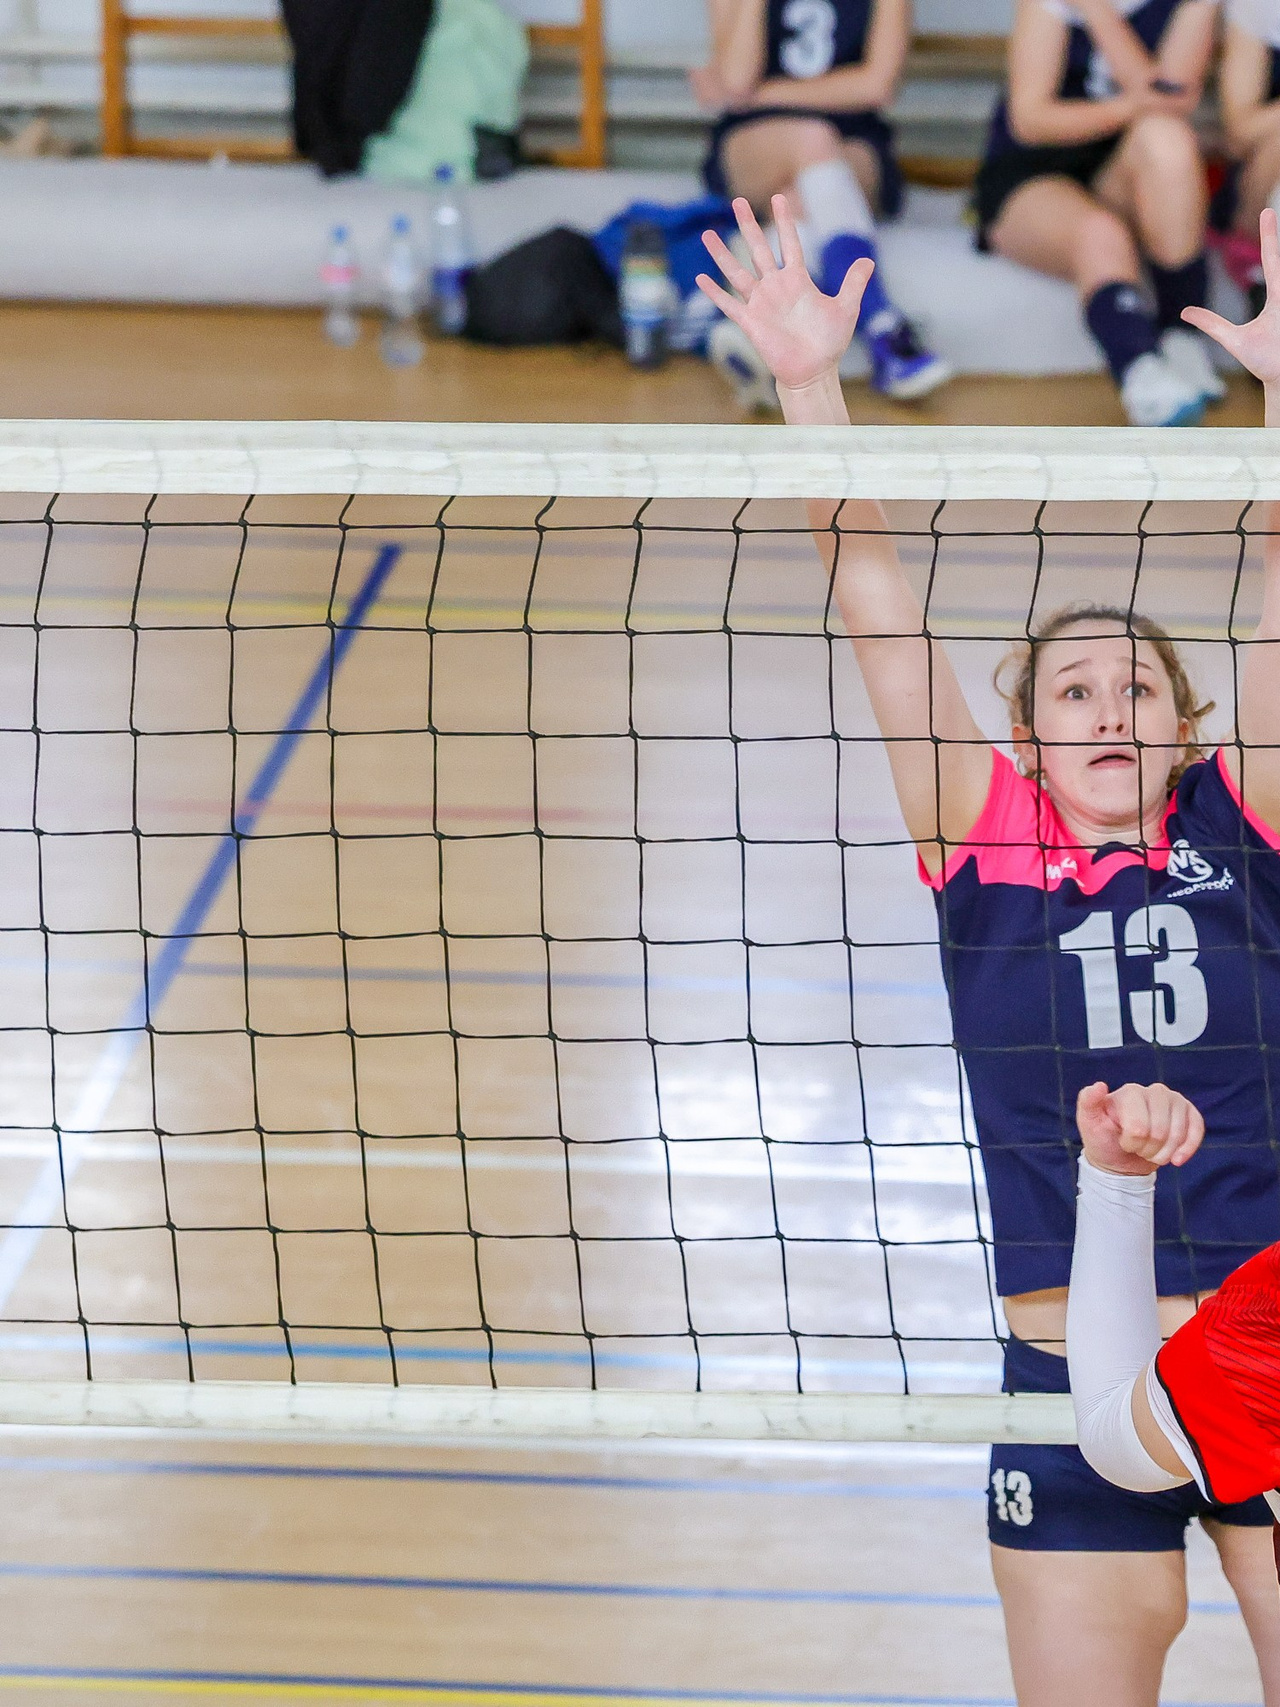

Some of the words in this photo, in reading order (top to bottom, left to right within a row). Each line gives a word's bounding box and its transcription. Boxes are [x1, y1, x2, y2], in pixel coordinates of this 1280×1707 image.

[779, 0, 837, 78] 3
[1059, 903, 1209, 1049] 13
[991, 1468, 1034, 1526] 13
